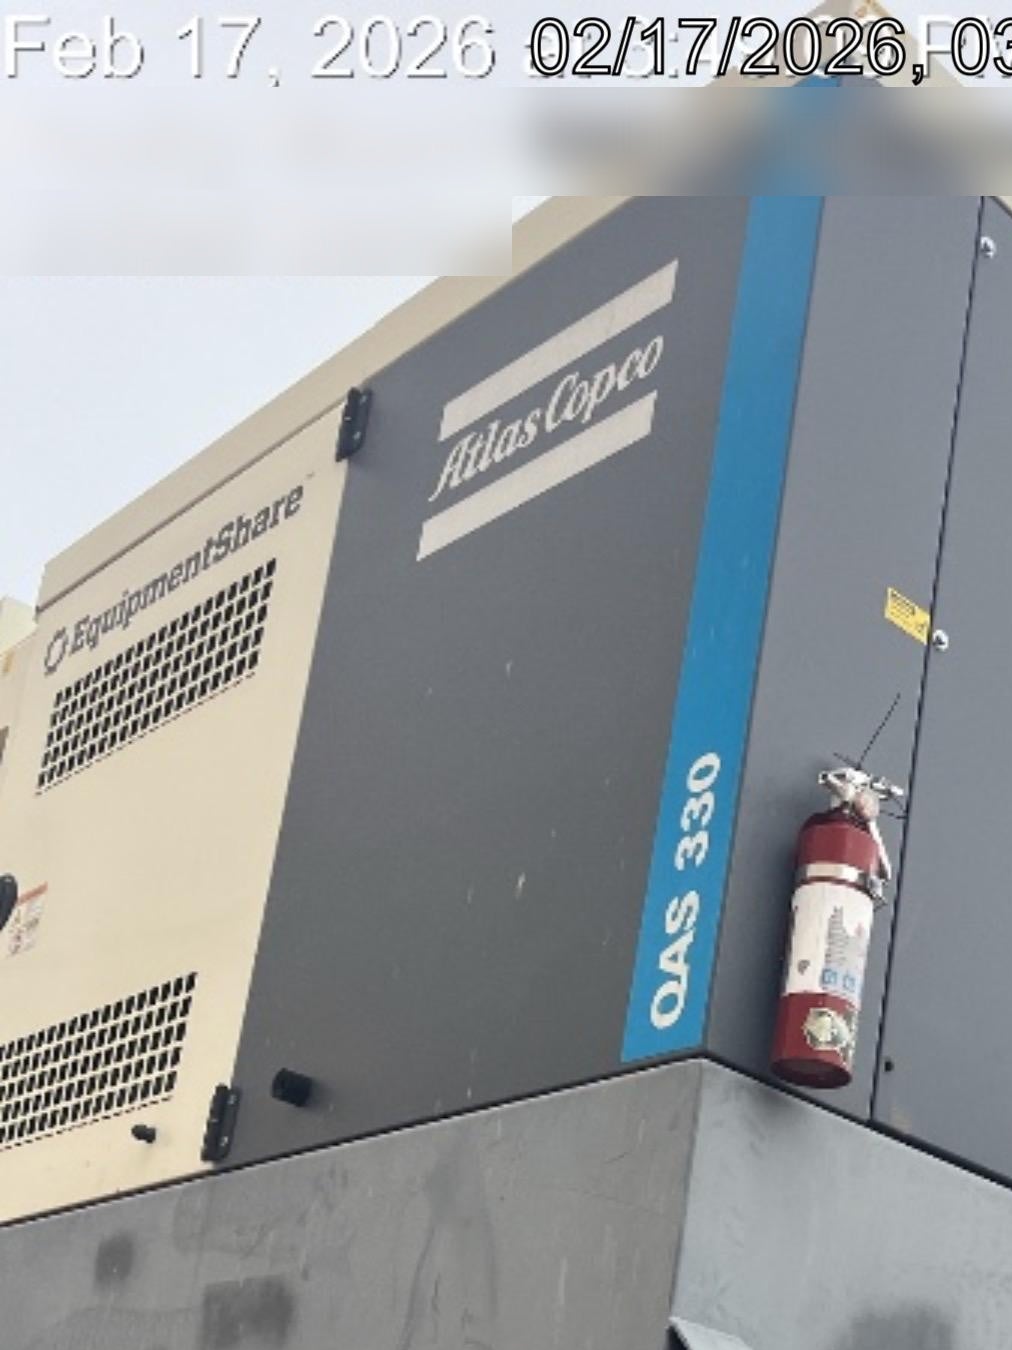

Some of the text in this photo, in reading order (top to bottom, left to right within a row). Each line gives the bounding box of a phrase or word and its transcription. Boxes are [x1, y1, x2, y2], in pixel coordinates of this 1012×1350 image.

[427, 335, 665, 503] Atlas Copco
[68, 484, 304, 656] EquipmentShare
[673, 751, 722, 872] 330
